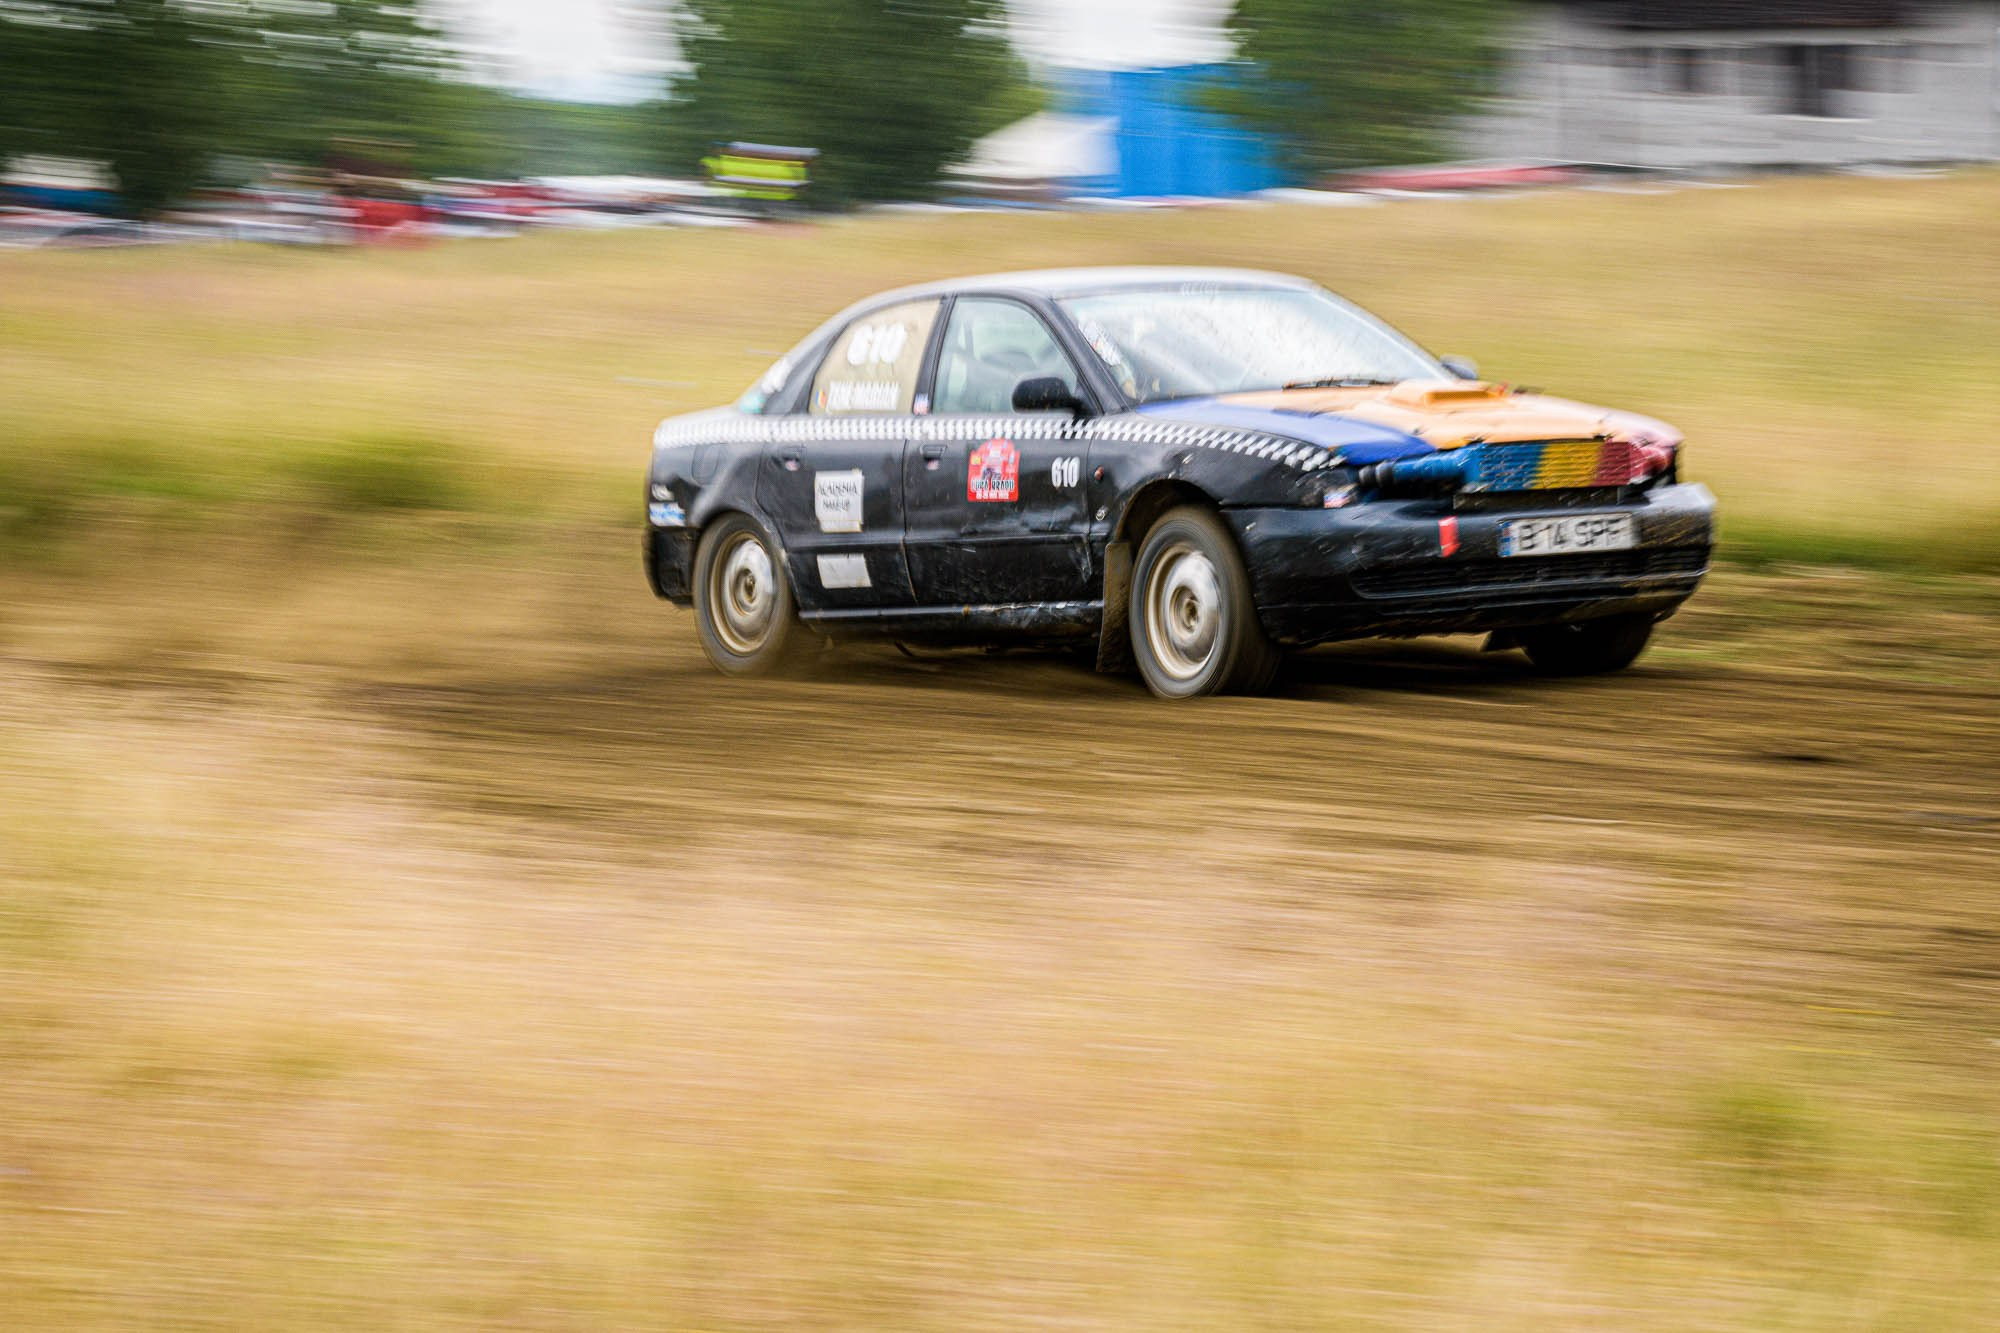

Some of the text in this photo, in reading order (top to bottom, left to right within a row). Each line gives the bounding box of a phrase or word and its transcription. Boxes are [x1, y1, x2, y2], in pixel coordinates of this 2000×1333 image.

[847, 322, 907, 366] 610
[1051, 457, 1080, 488] 610
[1519, 522, 1537, 551] B
